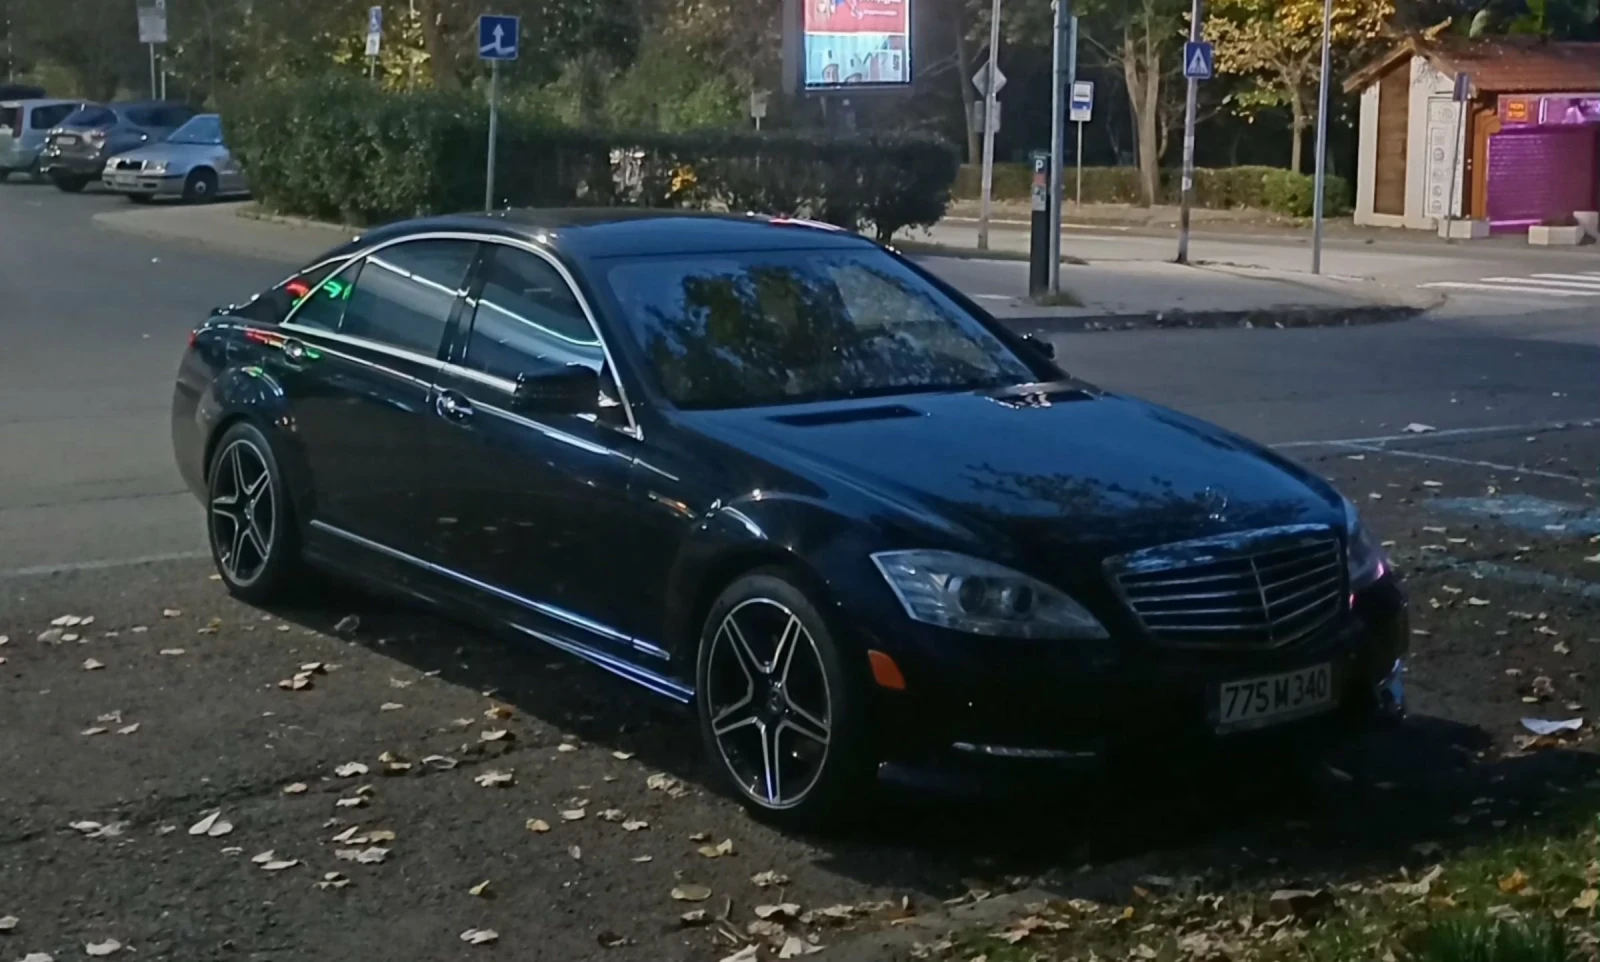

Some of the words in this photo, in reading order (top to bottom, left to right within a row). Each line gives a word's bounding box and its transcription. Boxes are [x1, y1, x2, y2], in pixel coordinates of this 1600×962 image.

[1035, 159, 1044, 172] P
[1225, 680, 1269, 718] 775
[1275, 677, 1288, 709] M
[1293, 668, 1327, 705] 340
